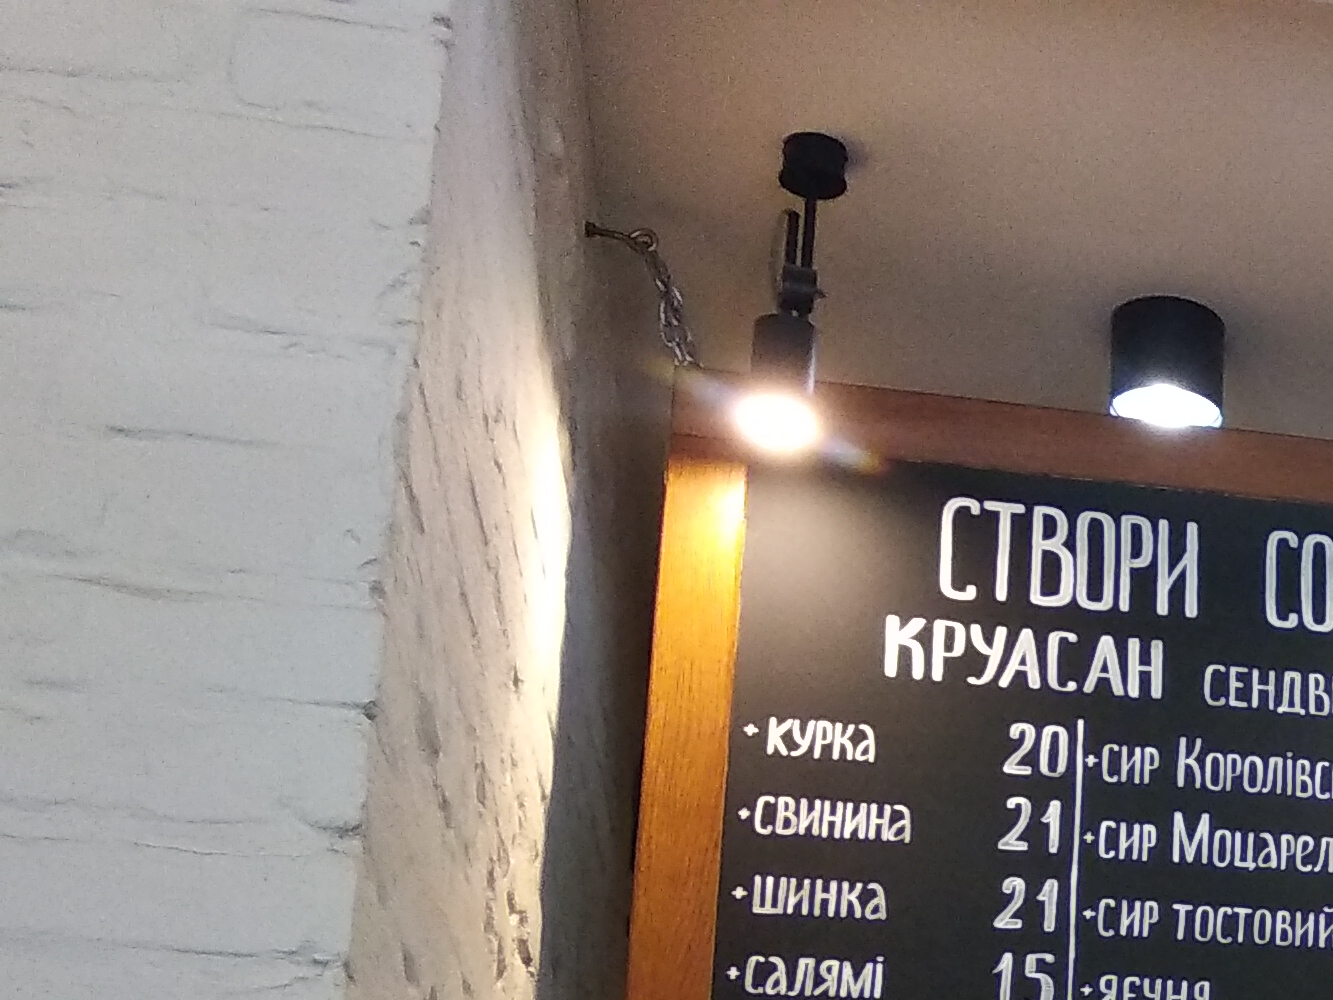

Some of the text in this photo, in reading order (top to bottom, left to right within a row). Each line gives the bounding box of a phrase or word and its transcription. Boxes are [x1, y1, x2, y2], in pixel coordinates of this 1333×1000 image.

[939, 497, 1199, 618] СТВОРИ
[884, 615, 1163, 699] КРУАСАН
[1003, 723, 1068, 777] 20
[998, 797, 1061, 853] 21
[993, 877, 1058, 932] 21
